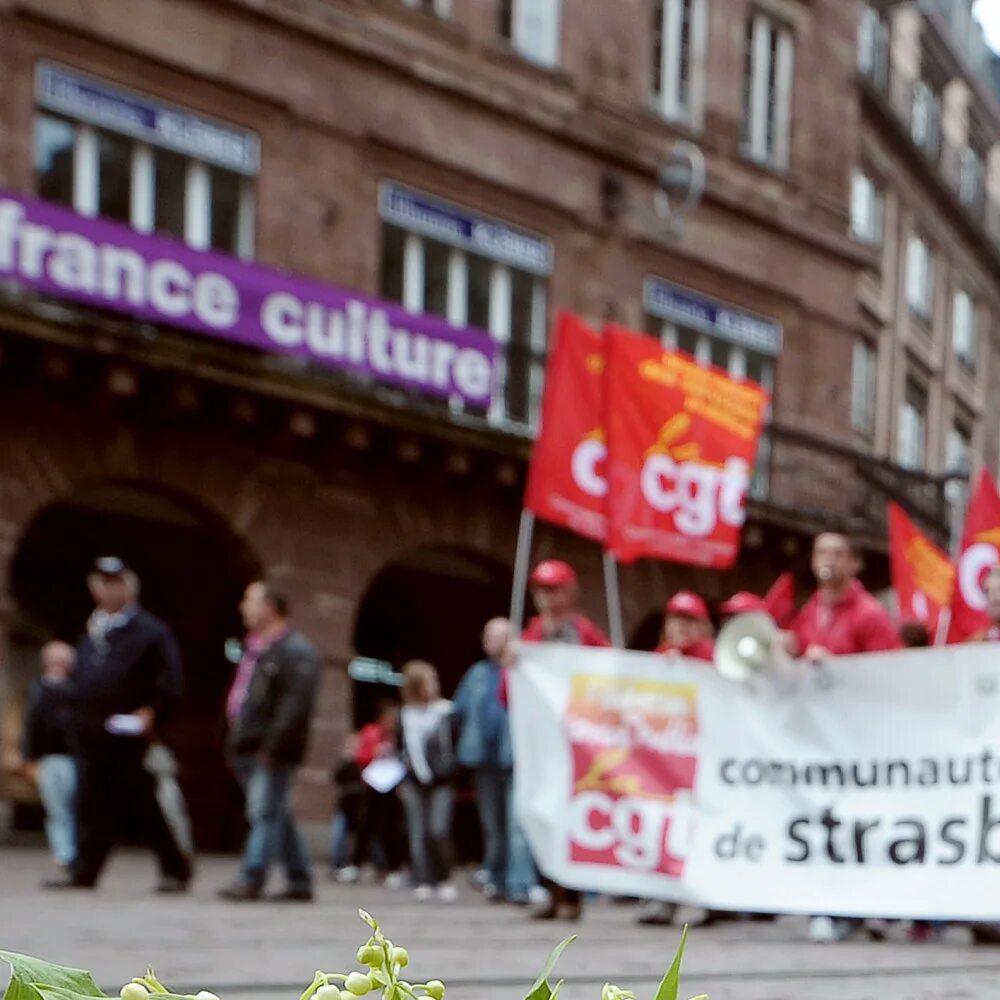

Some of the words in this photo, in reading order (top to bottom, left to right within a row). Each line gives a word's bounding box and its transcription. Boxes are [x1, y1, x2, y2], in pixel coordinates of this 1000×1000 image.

[0, 200, 239, 329] france
[260, 293, 491, 399] culture
[640, 454, 750, 537] cgt
[568, 786, 700, 870] cgt
[714, 823, 767, 861] de
